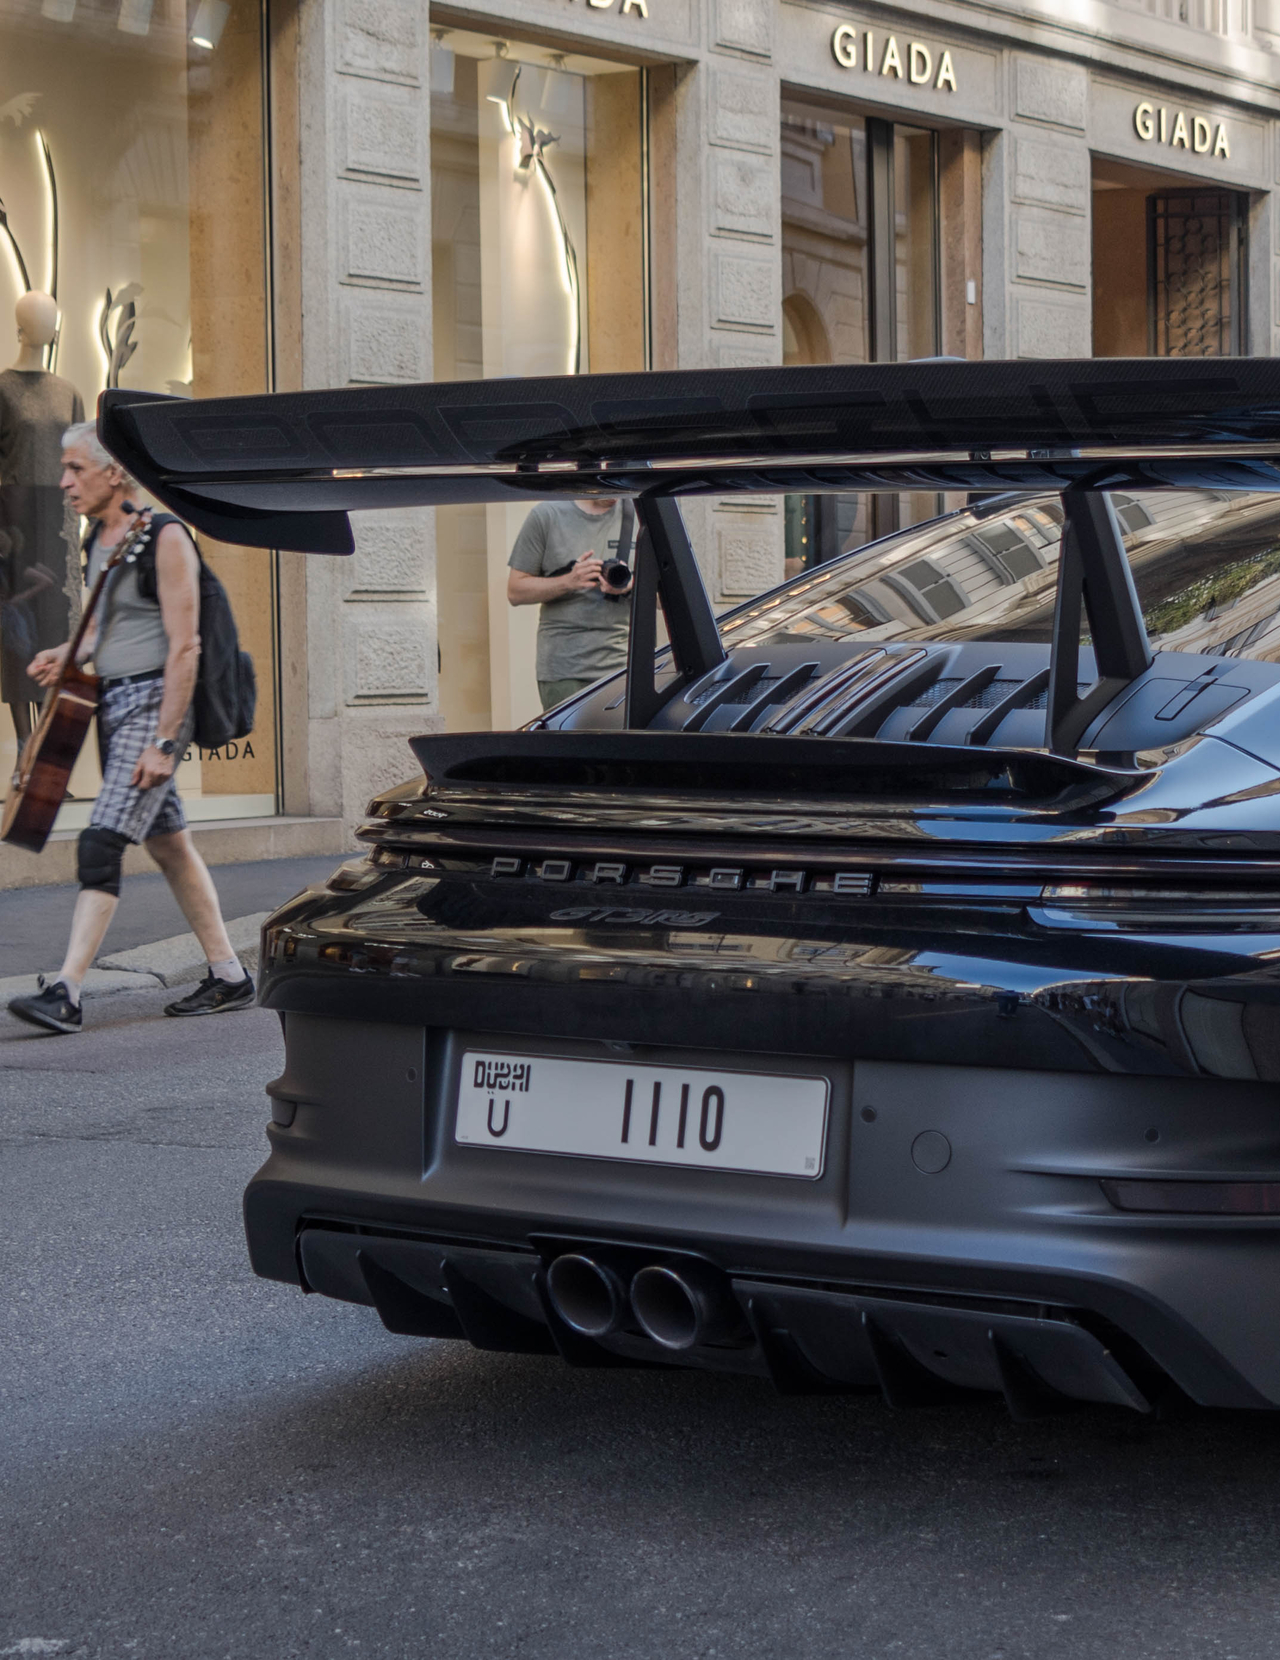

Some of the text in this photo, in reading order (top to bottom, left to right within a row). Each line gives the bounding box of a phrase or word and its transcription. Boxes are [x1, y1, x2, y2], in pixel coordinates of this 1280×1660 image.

[832, 24, 958, 92] GIADA
[1135, 102, 1231, 160] GIADA
[491, 857, 873, 896] PORSCHE
[487, 1078, 726, 1152] U 1110
